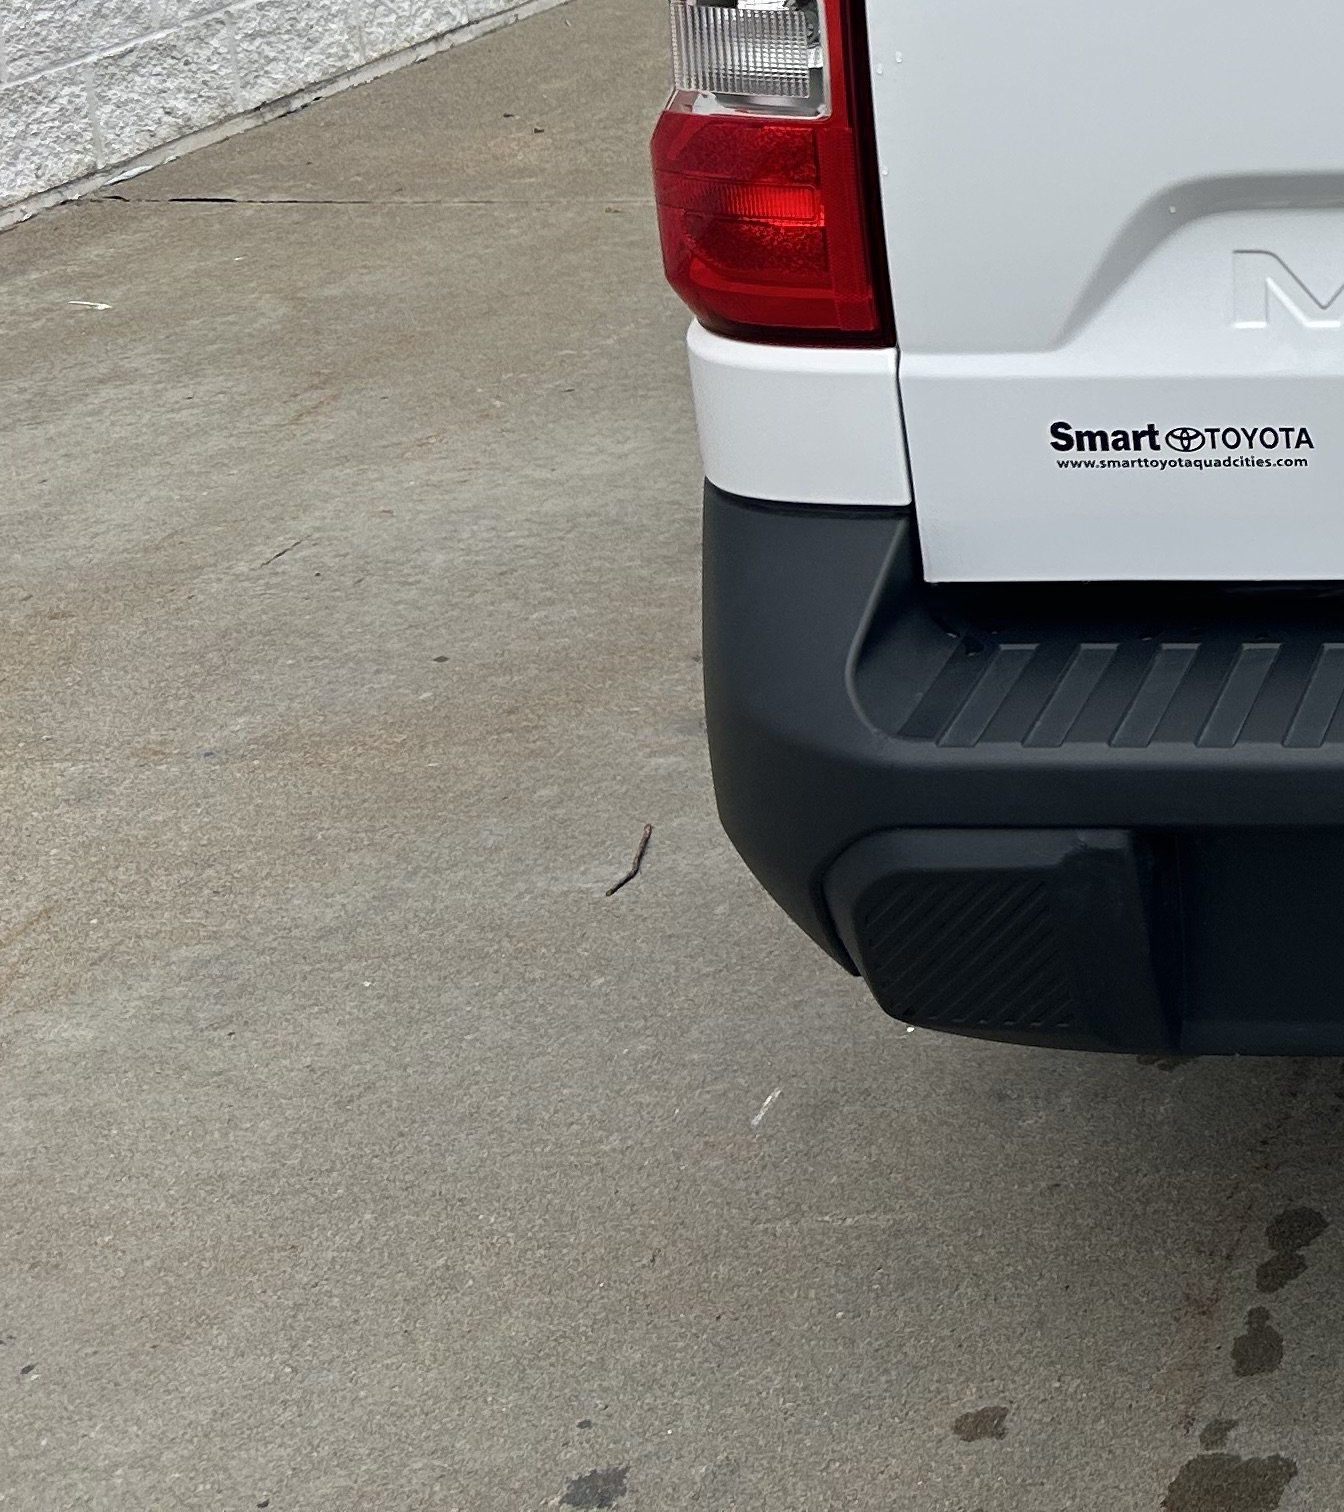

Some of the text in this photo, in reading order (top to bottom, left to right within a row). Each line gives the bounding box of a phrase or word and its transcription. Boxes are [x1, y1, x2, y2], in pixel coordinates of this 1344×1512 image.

[1049, 421, 1315, 452] Smart TOYOTA
[1056, 455, 1309, 471] www.smarttoyotaquadcities.com
